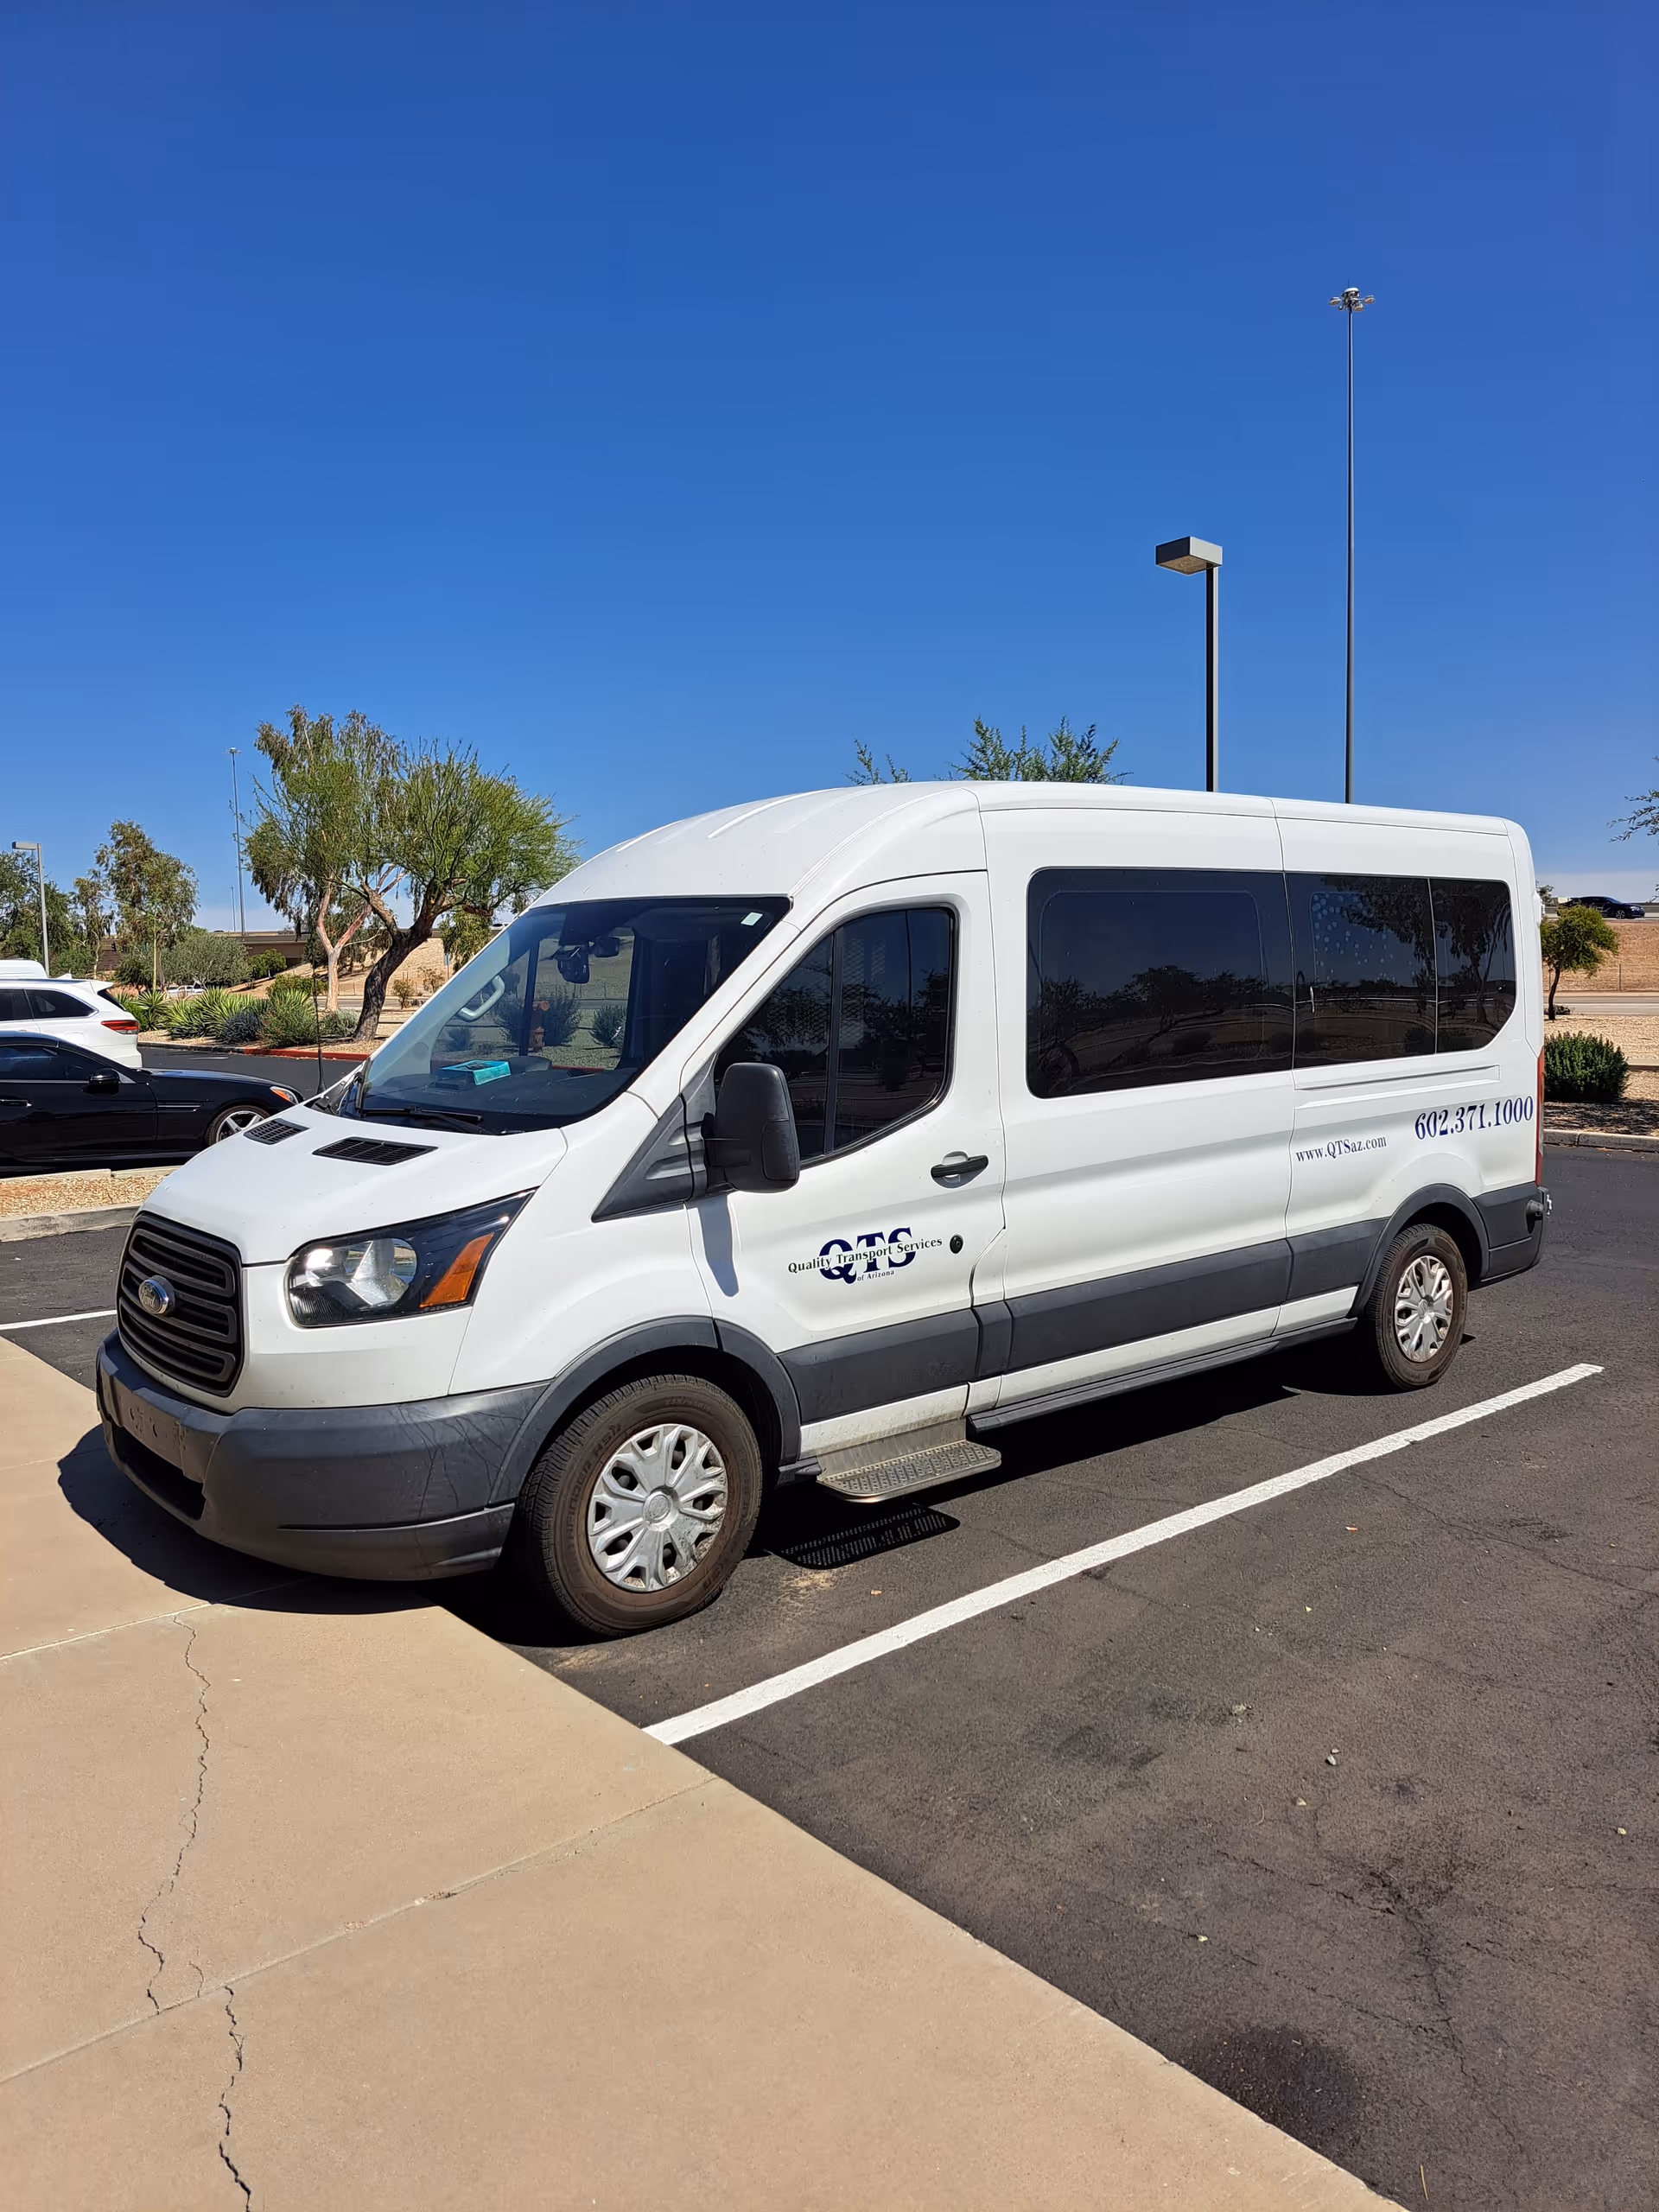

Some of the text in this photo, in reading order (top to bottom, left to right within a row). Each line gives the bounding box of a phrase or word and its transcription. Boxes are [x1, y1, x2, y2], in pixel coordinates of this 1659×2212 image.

[1414, 1096, 1534, 1140] 602.371.1000
[1295, 1135, 1387, 1162] www.QTSaz.com
[788, 1238, 943, 1274] Quality Transport Services
[818, 1227, 916, 1284] QTS
[867, 1269, 894, 1280] Arizona
